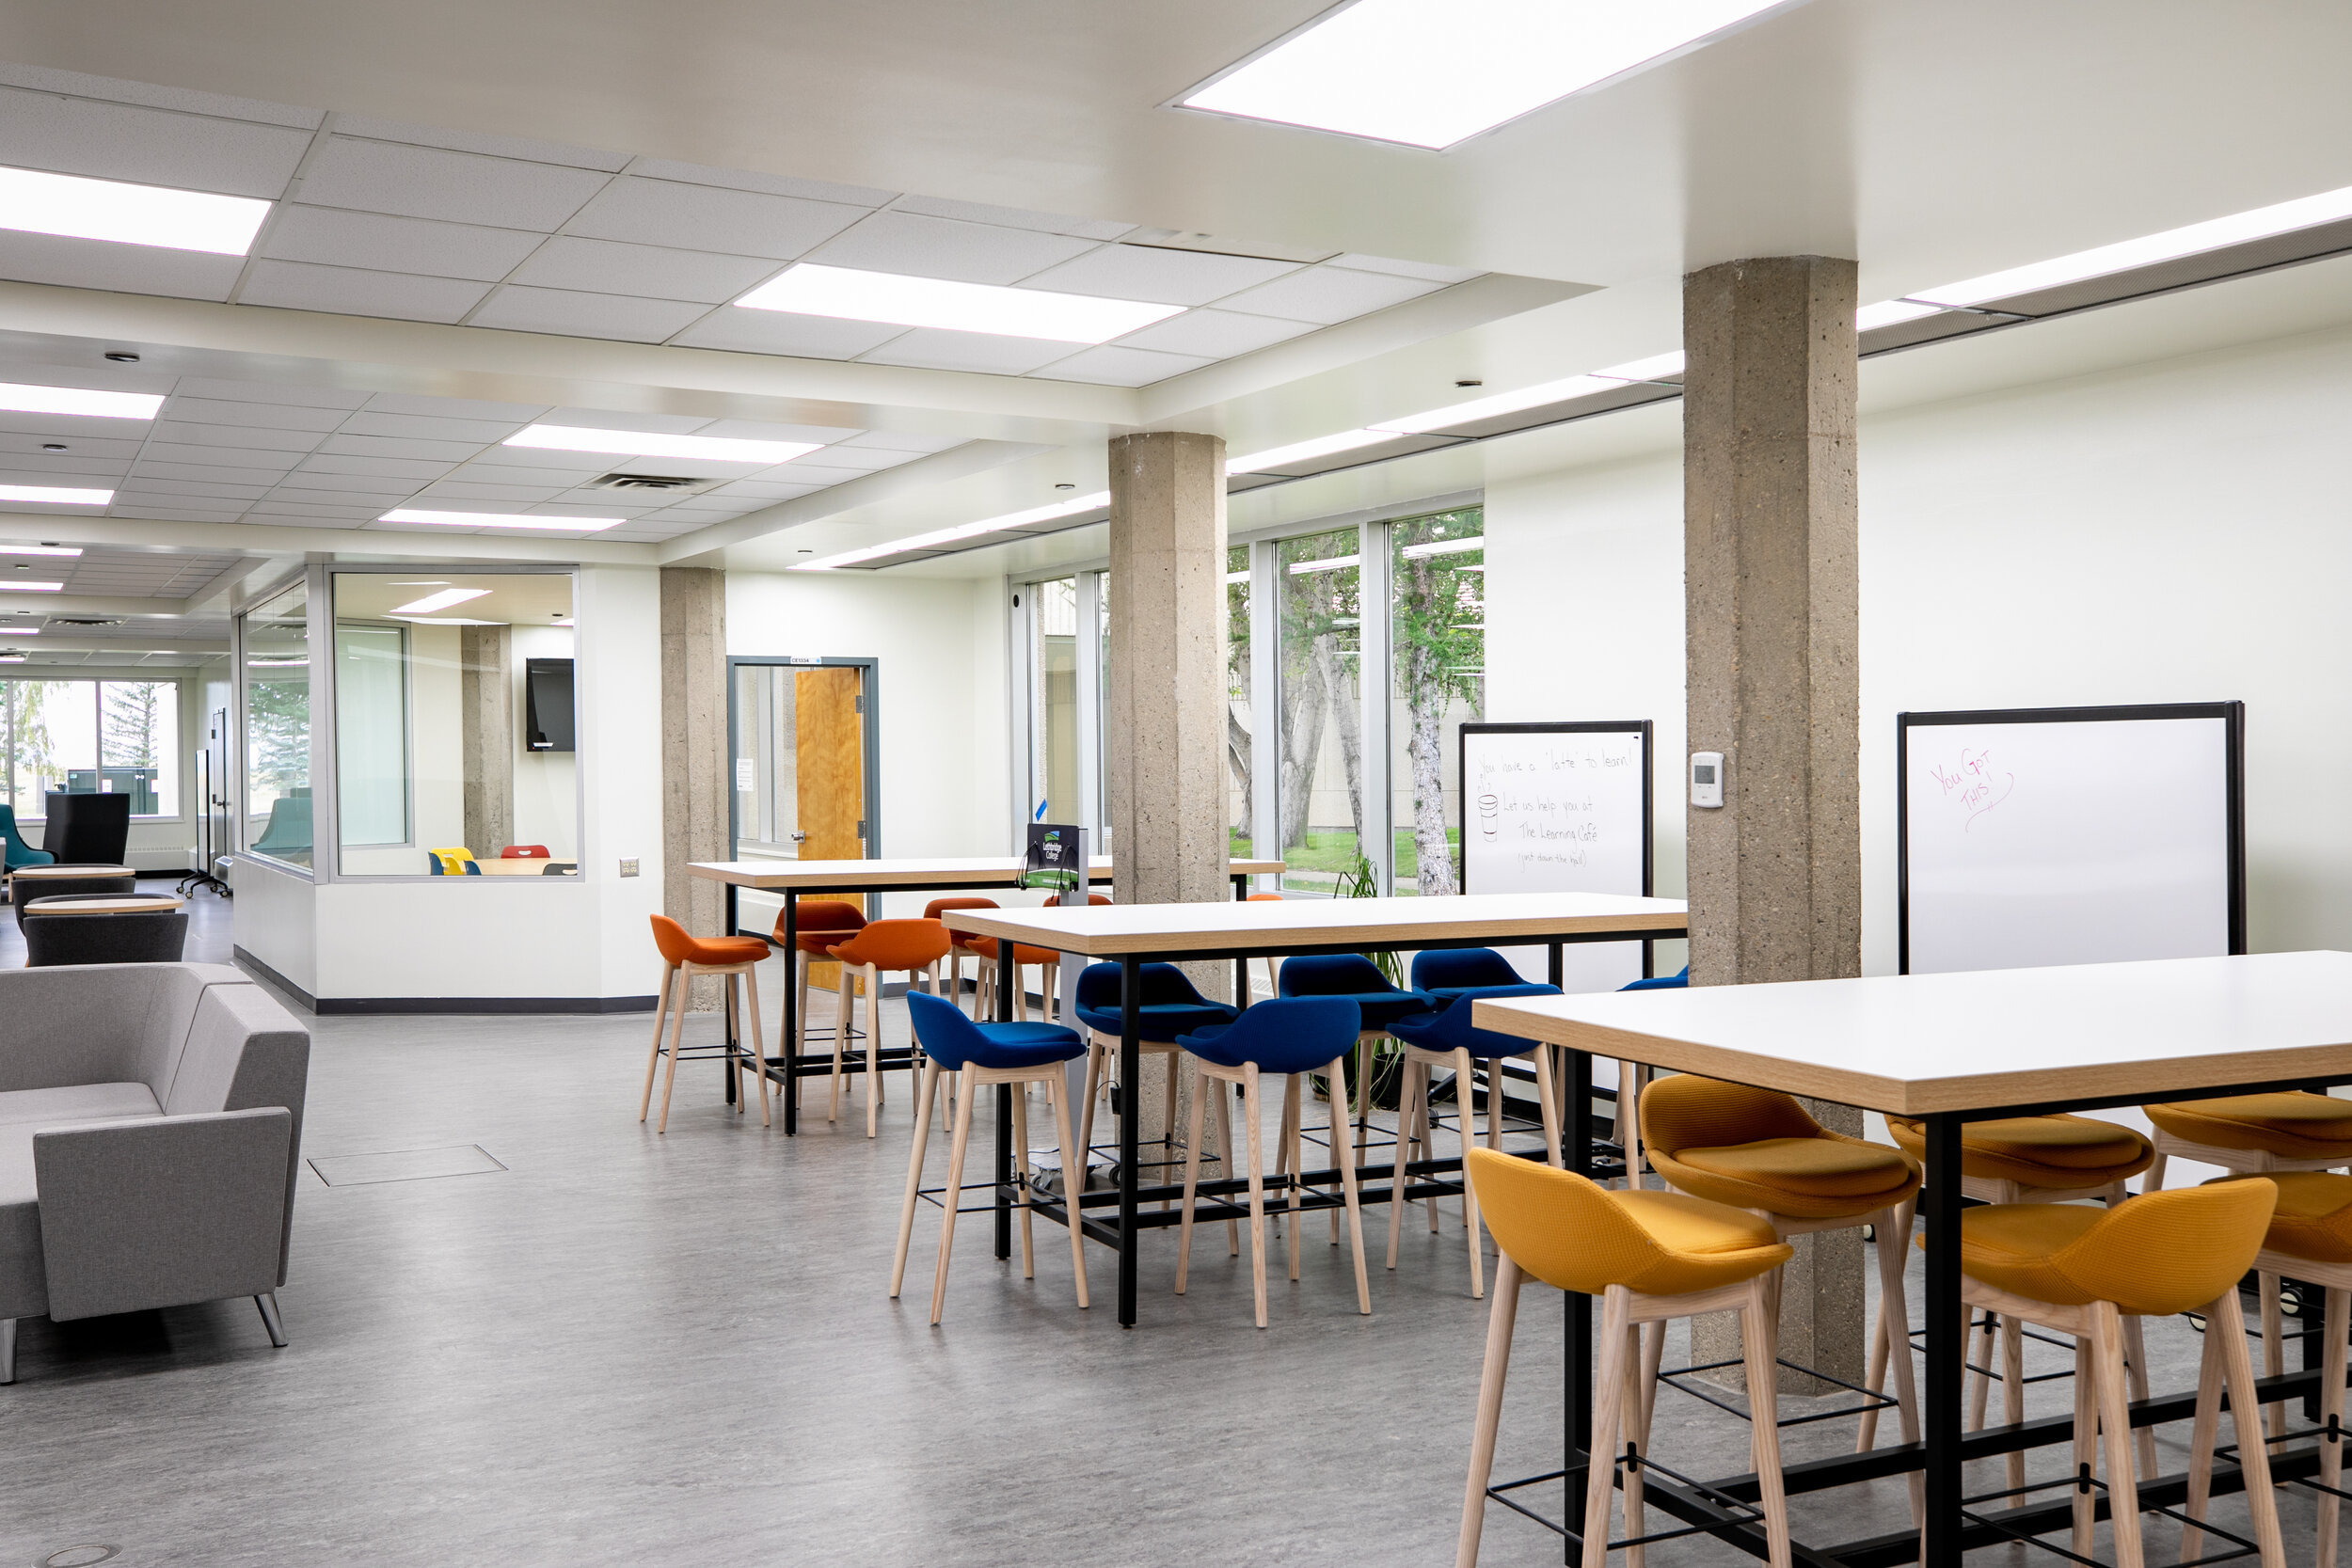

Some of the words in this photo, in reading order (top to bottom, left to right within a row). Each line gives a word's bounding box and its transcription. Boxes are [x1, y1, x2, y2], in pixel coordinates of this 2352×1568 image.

[1502, 752, 1523, 773] have
[1528, 763, 1536, 772] a
[1584, 752, 1597, 768] to
[1503, 791, 1518, 812] Let
[1522, 802, 1534, 812] us
[1537, 797, 1557, 818] help
[1563, 800, 1579, 819] you
[1582, 795, 1594, 812] at
[1518, 821, 1535, 839] The
[1539, 821, 1578, 853] Learning
[1537, 853, 1553, 864] down
[1554, 852, 1568, 864] the
